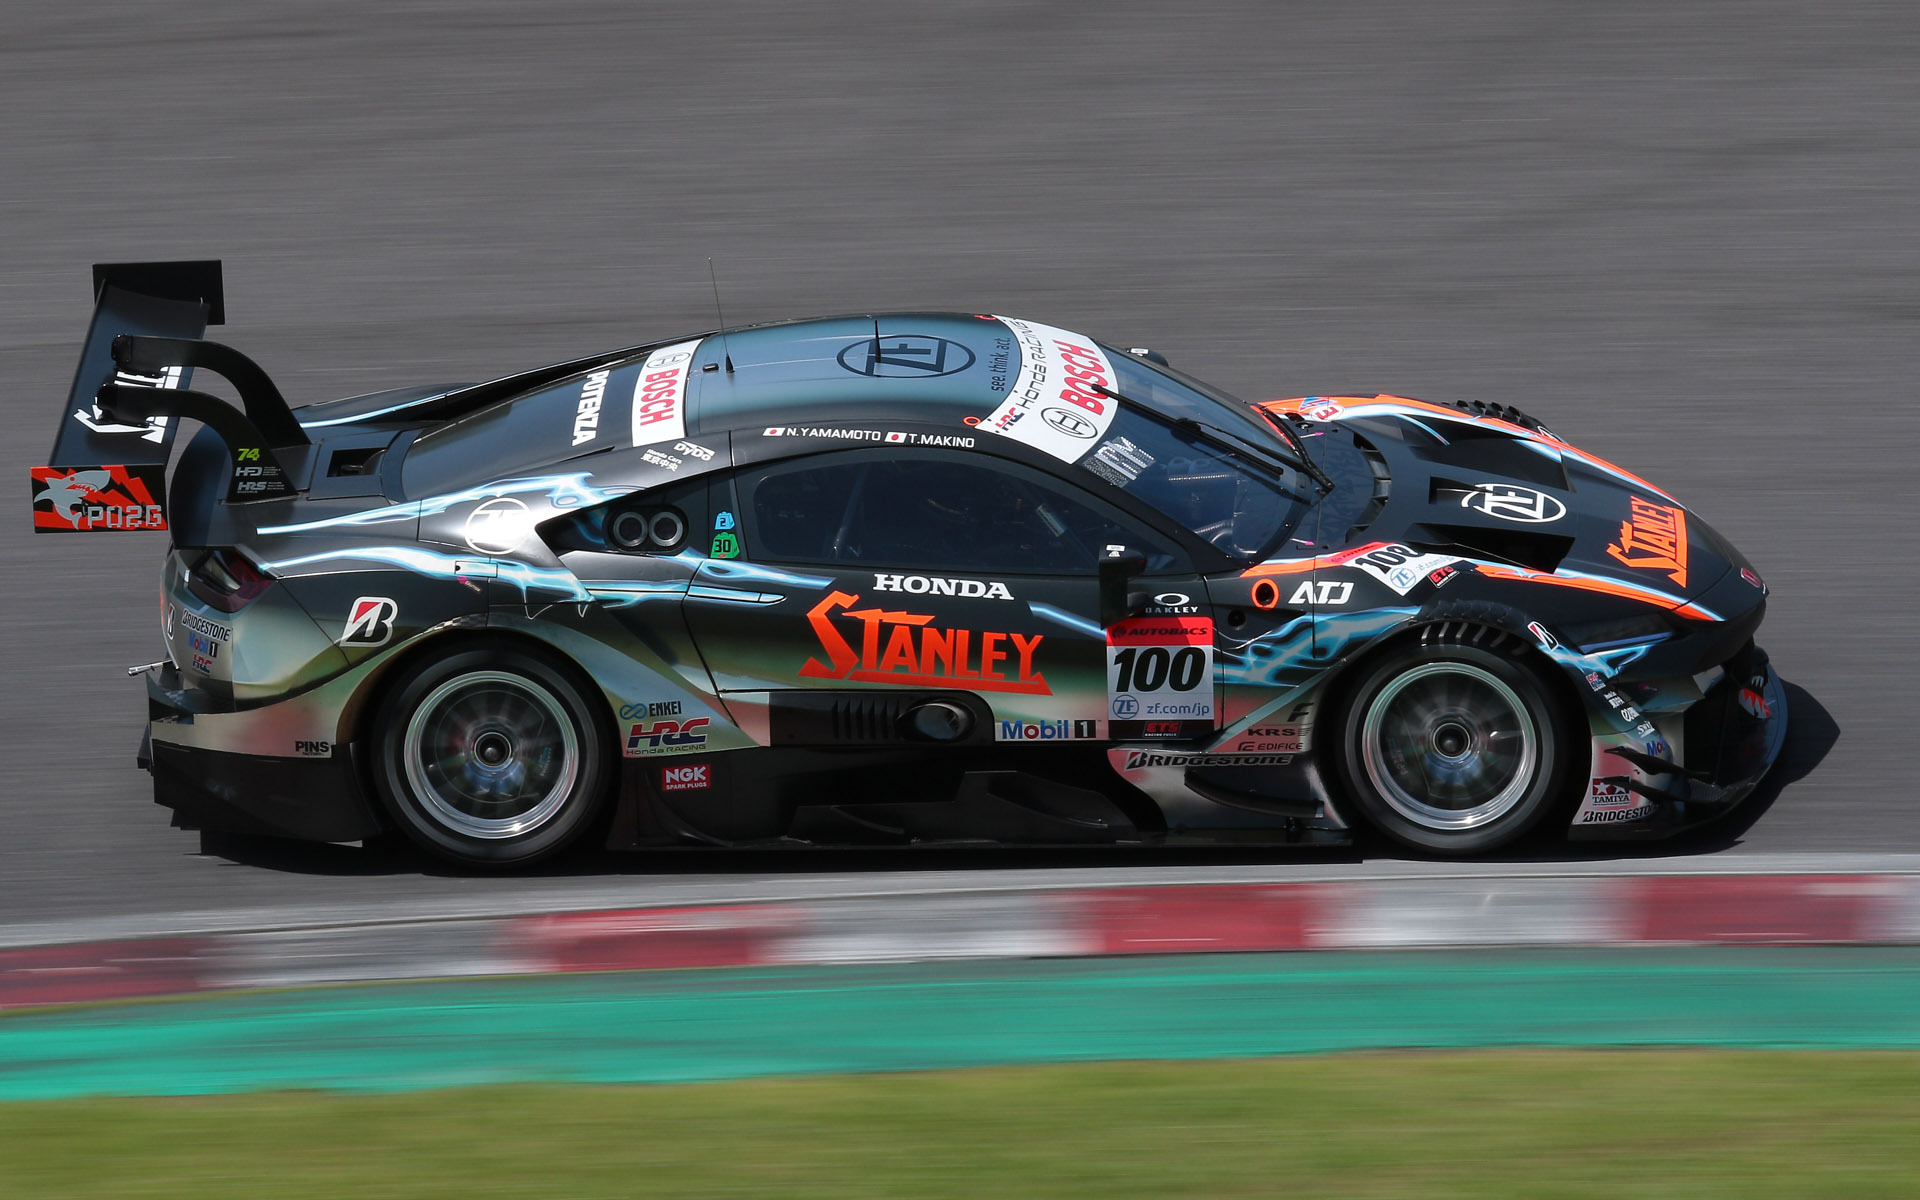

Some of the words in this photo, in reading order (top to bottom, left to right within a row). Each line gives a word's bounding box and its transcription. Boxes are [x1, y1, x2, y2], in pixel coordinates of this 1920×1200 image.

[1053, 338, 1108, 416] BOSCH
[1016, 363, 1047, 409] Honda
[640, 368, 680, 426] BOSCH
[572, 370, 610, 447] POTENZA
[786, 427, 881, 441] N.YAMAMOTO
[909, 433, 975, 448] T.MAKINO
[237, 448, 260, 461] 74
[237, 481, 267, 491] HRS
[720, 517, 726, 527] 2
[714, 539, 731, 553] 30
[1606, 495, 1688, 589] STANLEY
[1355, 545, 1423, 574] 100
[873, 573, 1014, 600] HONDA
[1145, 606, 1198, 614] OAKLEY
[182, 609, 231, 642] BRIDGESTONE
[1129, 627, 1208, 637] AUTOBACS
[797, 590, 1053, 696] STANLEY
[1113, 647, 1206, 692] 100
[649, 701, 682, 717] ENKEI
[1147, 703, 1210, 716] zf.com/jp
[626, 717, 710, 749] HRC
[1002, 720, 1069, 739] Mobil
[295, 741, 330, 753] PINS
[666, 744, 706, 753] RACING
[1257, 742, 1304, 750] EDIFICE
[1126, 752, 1292, 770] BRIDGESTONE
[665, 766, 706, 783] NGK
[1592, 795, 1630, 803] TAMIYA
